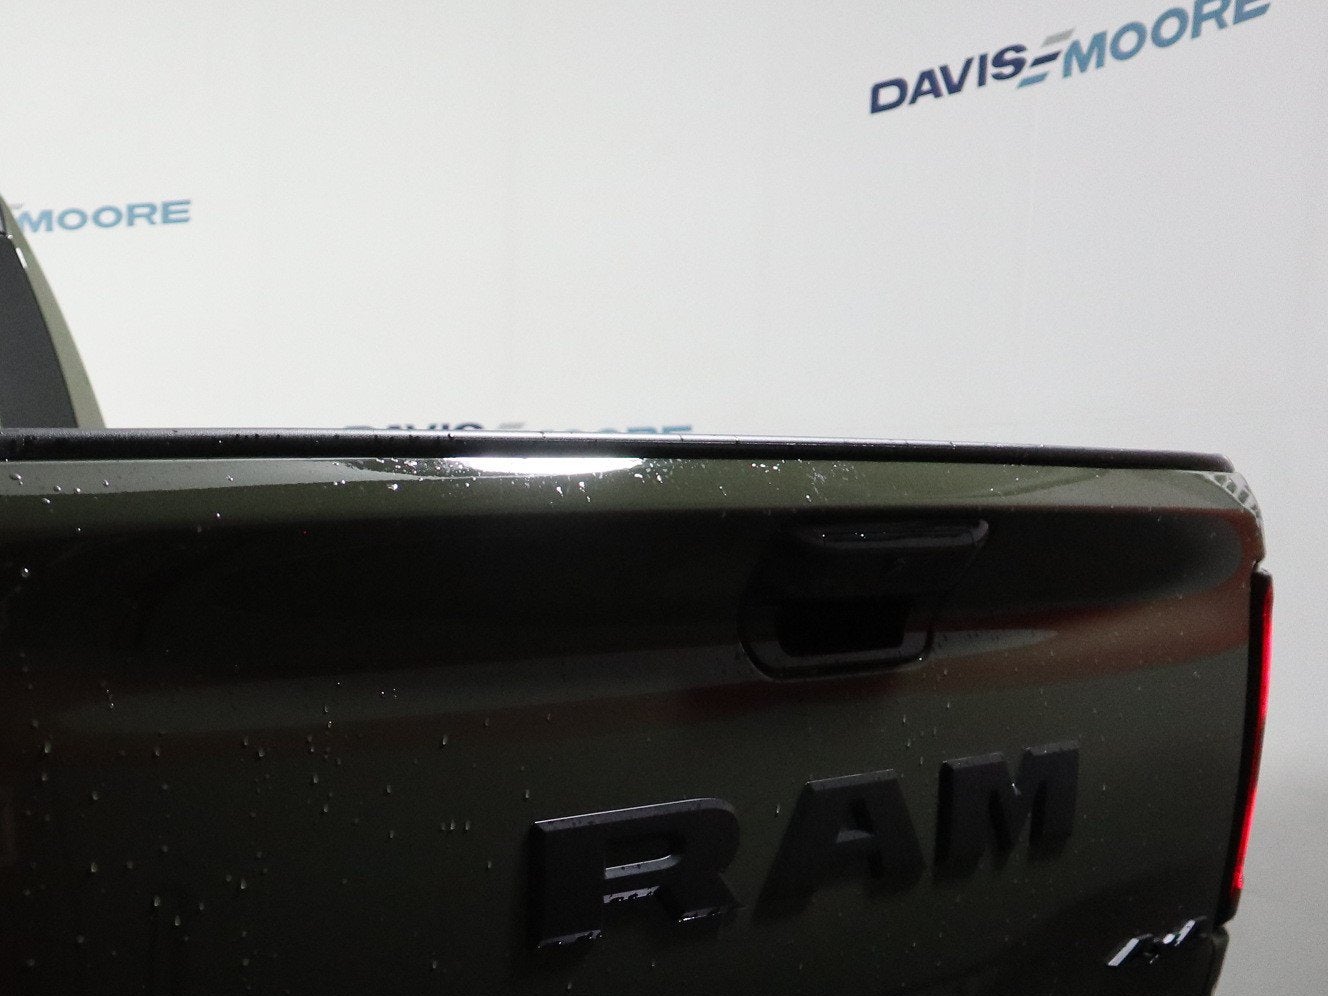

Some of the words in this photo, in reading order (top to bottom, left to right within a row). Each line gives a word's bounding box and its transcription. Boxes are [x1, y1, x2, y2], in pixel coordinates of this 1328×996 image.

[869, 43, 1027, 115] DAVIS
[1062, 0, 1271, 79] MOORE
[18, 199, 192, 233] MOORE
[524, 738, 1082, 950] RAM
